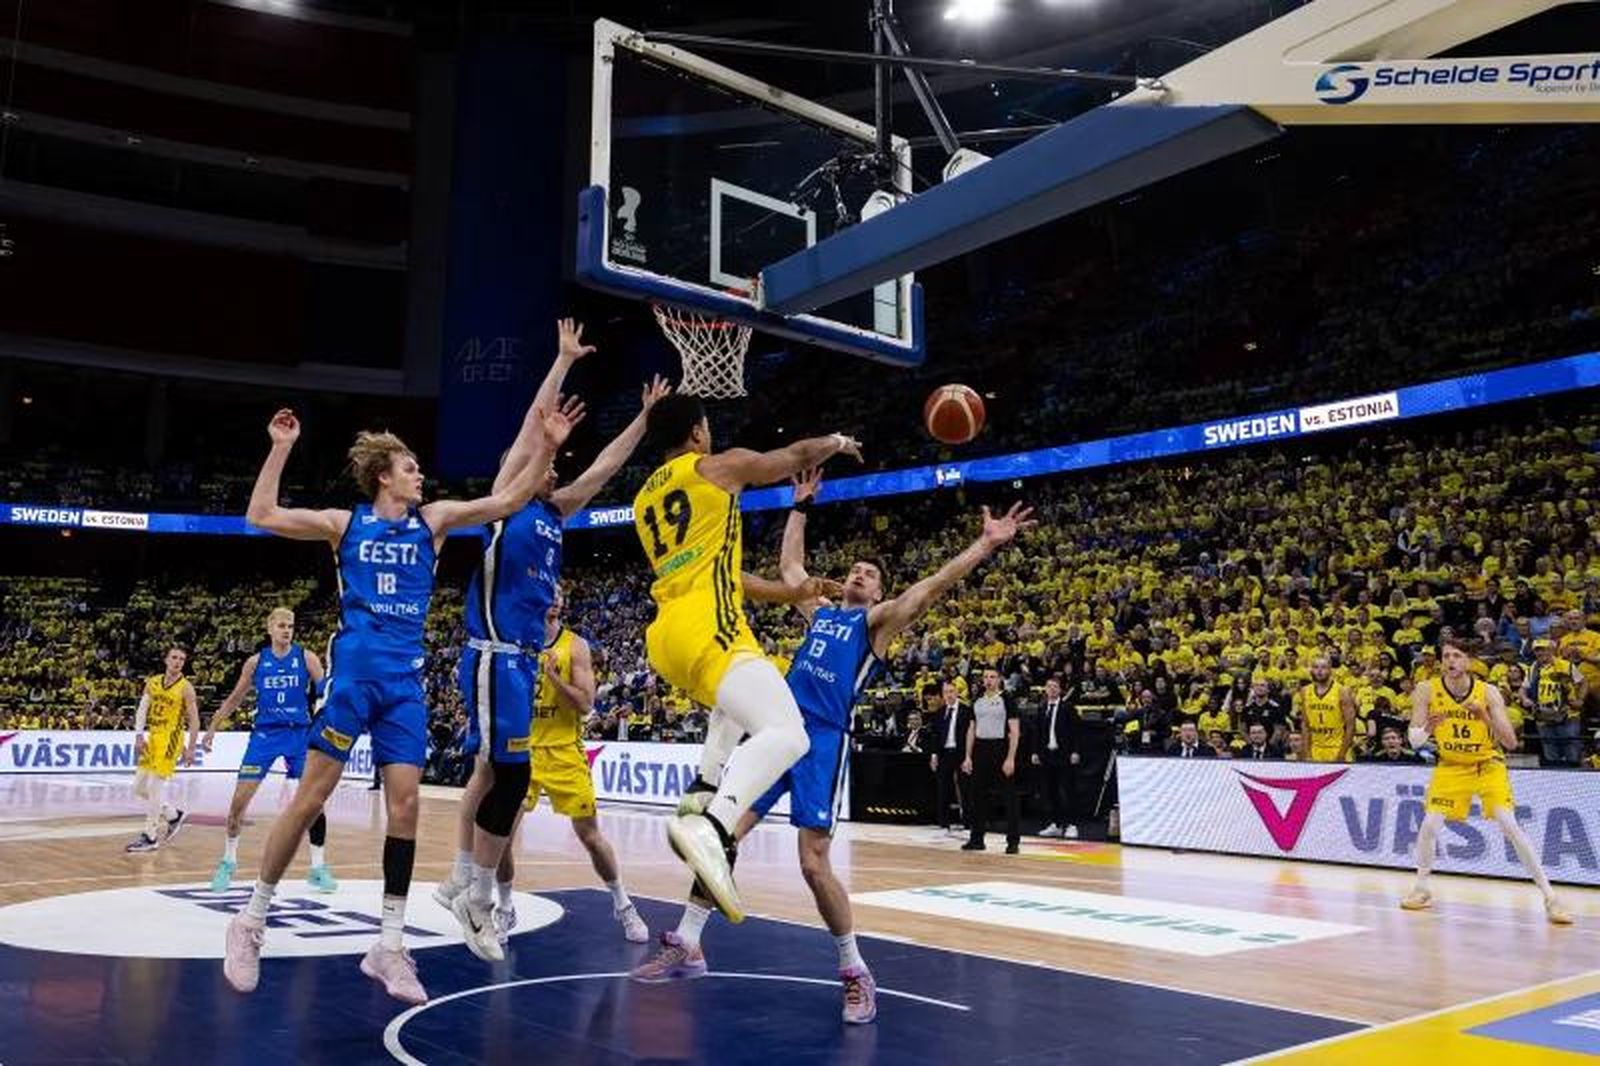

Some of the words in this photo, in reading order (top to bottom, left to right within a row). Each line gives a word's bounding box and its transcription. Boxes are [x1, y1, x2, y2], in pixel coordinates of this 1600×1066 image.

[1374, 65, 1498, 86] Schelde
[1204, 413, 1295, 445] SWEDEN
[1304, 416, 1324, 426] vs.
[1328, 400, 1393, 423] ESTONIA
[11, 508, 80, 524] SWEDEN
[102, 515, 144, 526] ESTONIA
[643, 488, 691, 560] 19
[360, 540, 418, 565] EESTI
[376, 572, 396, 595] 18
[811, 619, 852, 641] EESTI
[808, 638, 827, 658] 13
[264, 674, 299, 689] EESTI
[277, 691, 285, 704] 0
[1452, 723, 1471, 739] 16
